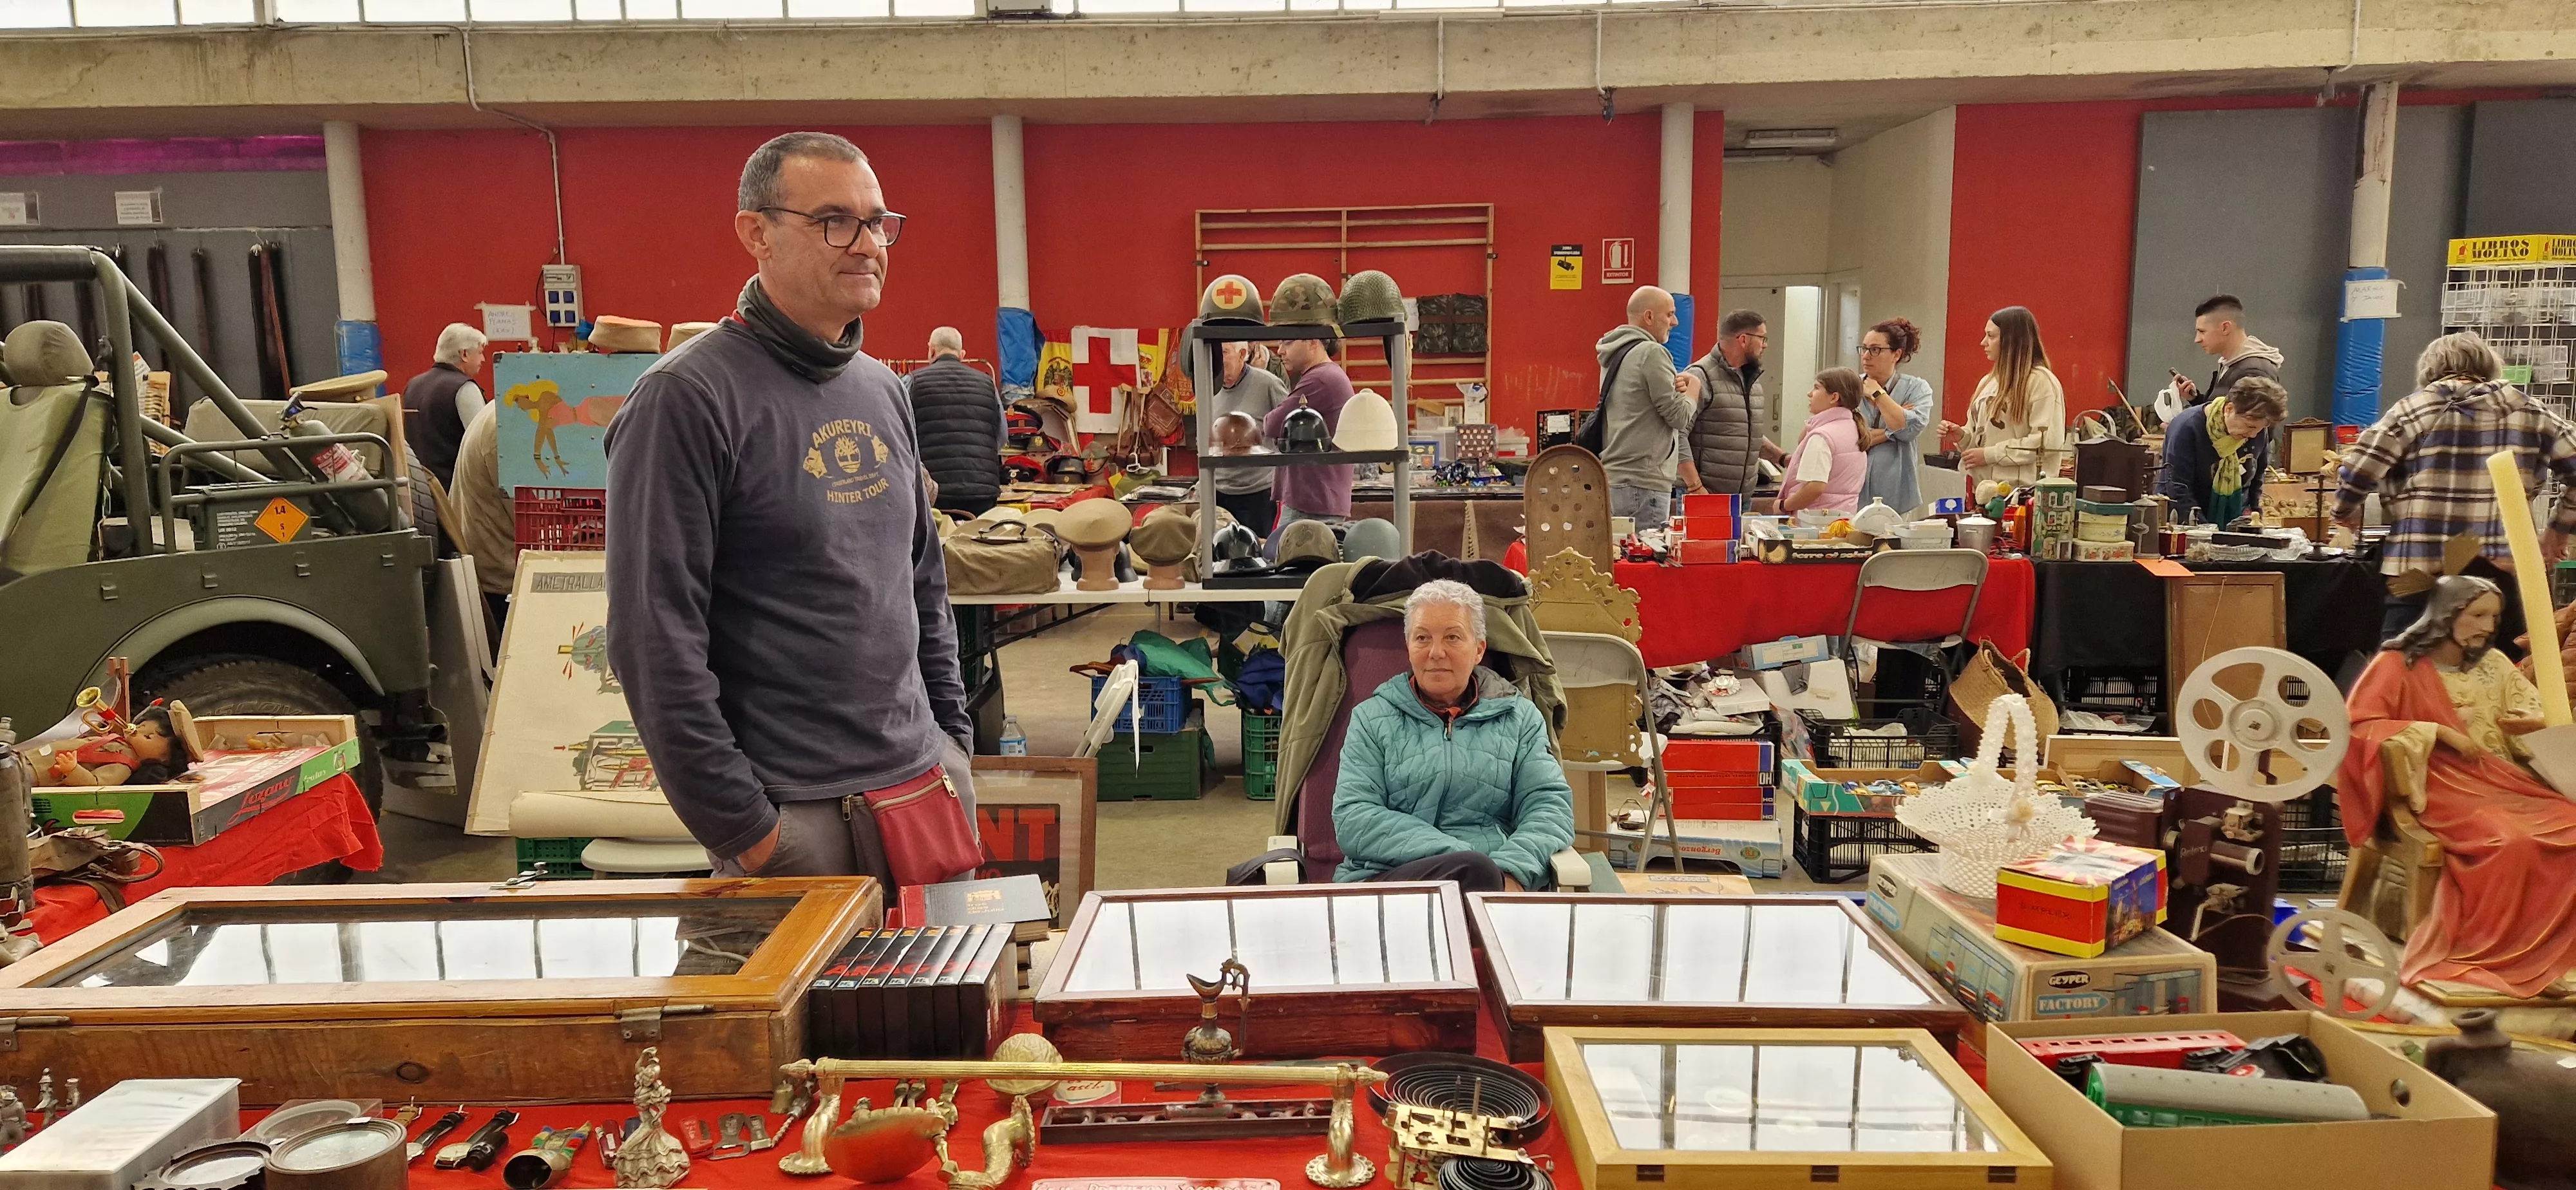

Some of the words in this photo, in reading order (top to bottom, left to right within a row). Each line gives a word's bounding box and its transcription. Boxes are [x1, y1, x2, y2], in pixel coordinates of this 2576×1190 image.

[2472, 238, 2530, 250] LIBROS
[2472, 247, 2530, 258] MOLINO
[811, 419, 873, 449] AKUREYRI
[826, 489, 863, 504] HINTER
[862, 478, 889, 498] TOUR
[274, 505, 287, 515] 1.4
[2048, 974, 2090, 986] GEYPER
[2039, 997, 2100, 1011] FACTORY
